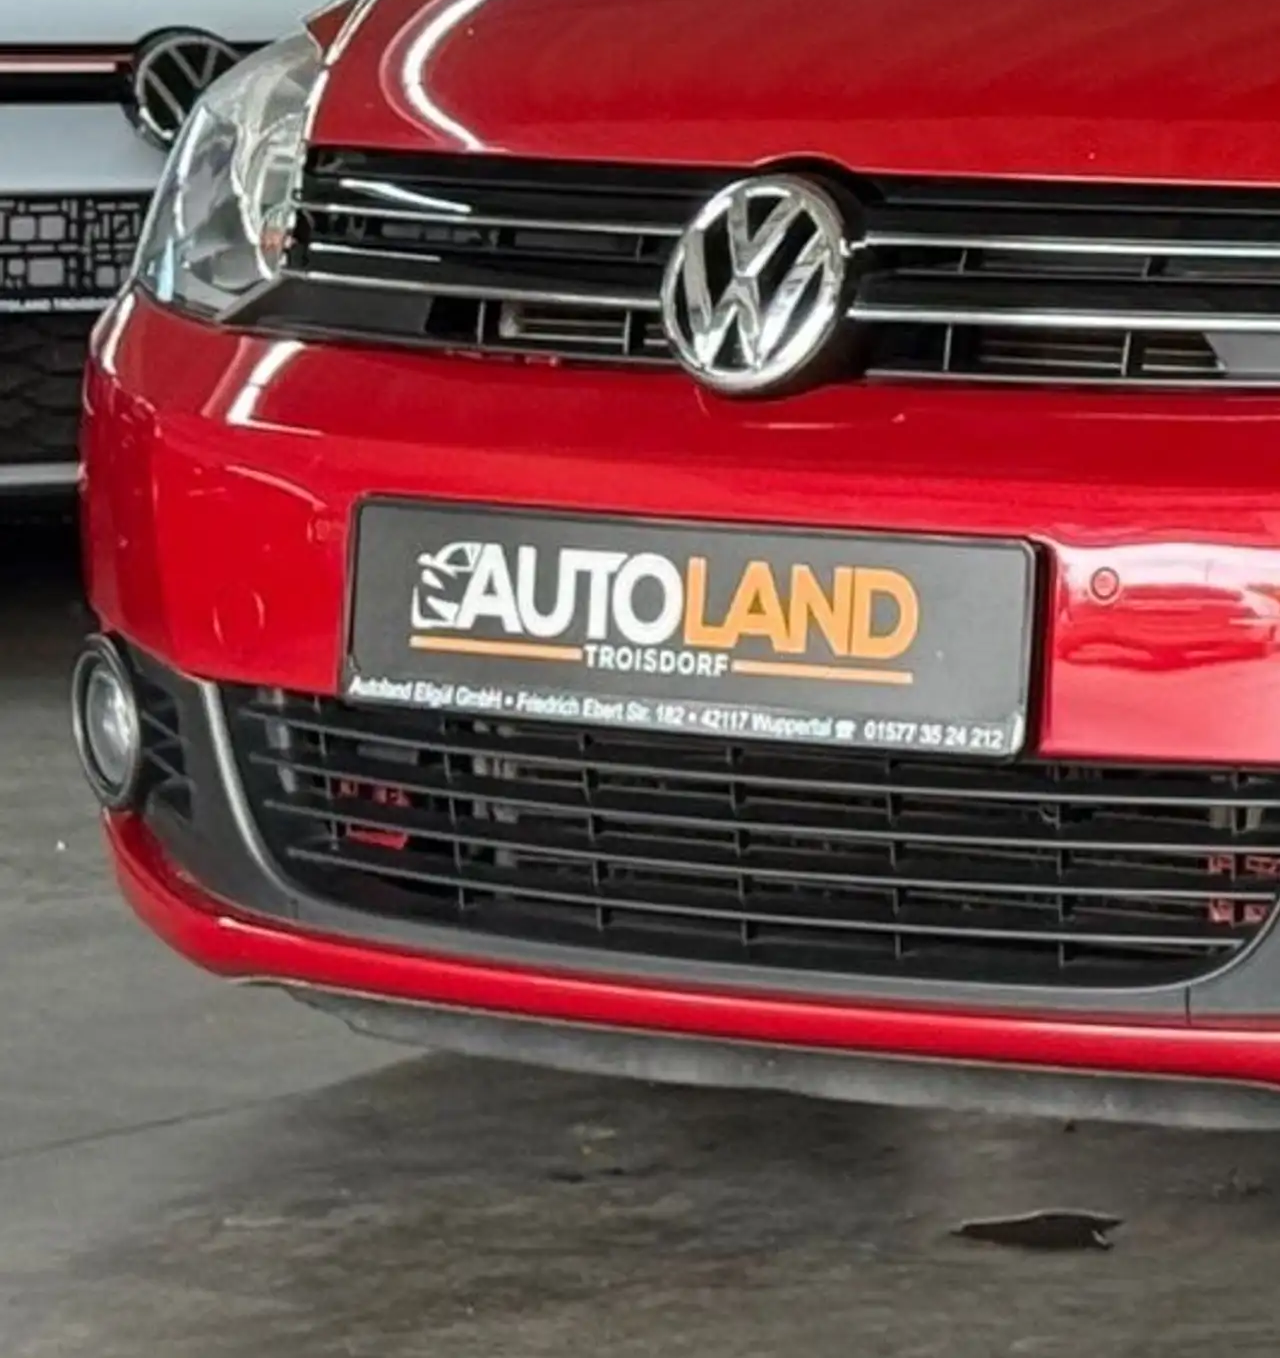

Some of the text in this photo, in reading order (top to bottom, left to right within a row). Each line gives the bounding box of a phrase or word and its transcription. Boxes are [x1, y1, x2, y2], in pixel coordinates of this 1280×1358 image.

[454, 541, 919, 660] AUTOLAND
[583, 643, 730, 678] TROISDORF
[456, 685, 503, 711] GmbH
[515, 691, 579, 715] Friedrich
[582, 696, 624, 721] Ebert
[656, 702, 686, 725] 182
[701, 708, 750, 731] 42117
[751, 711, 833, 738] Wuppertal
[863, 718, 914, 742] 01577
[919, 721, 943, 745] 35
[945, 723, 968, 747] 24
[970, 727, 1004, 750] 212
